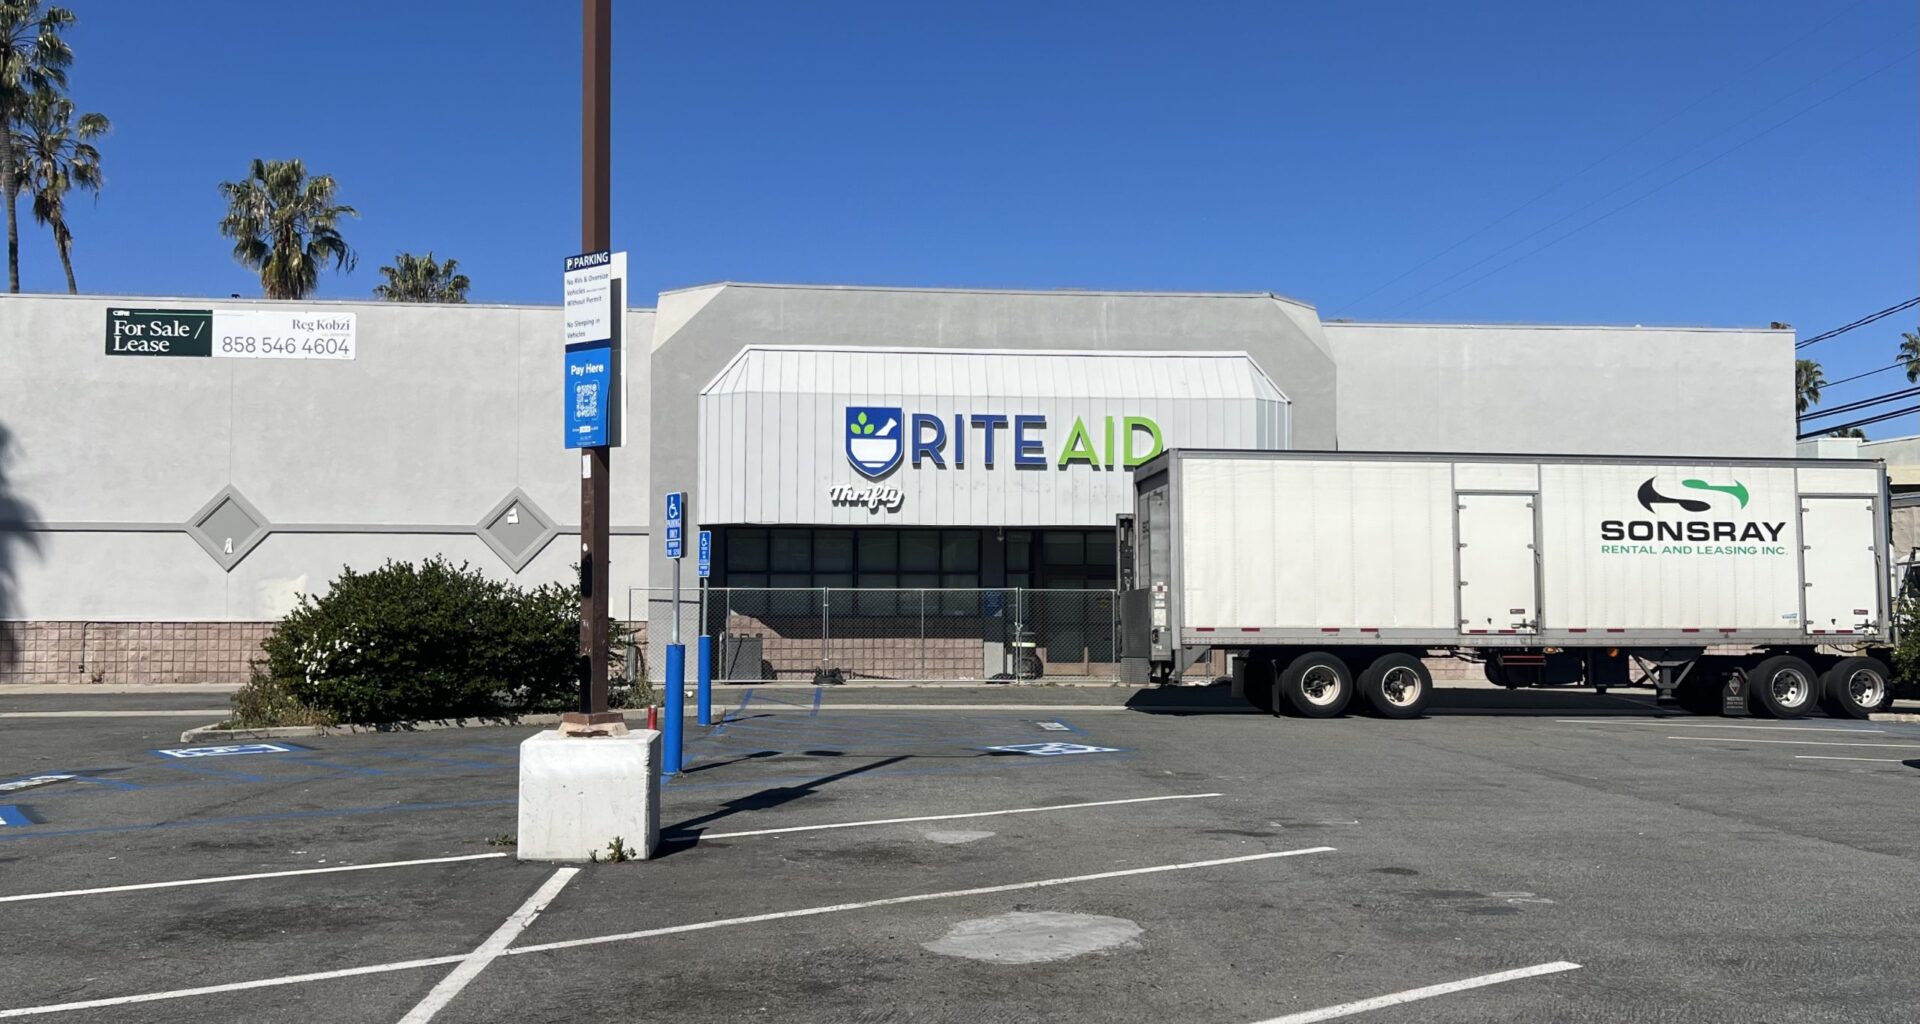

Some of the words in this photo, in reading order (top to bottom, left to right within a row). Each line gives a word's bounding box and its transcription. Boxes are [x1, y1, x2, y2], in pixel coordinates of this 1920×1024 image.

[574, 252, 608, 268] PARKING
[113, 320, 146, 336] For
[150, 320, 190, 337] Sale
[194, 320, 205, 340] /
[292, 320, 314, 332] Reg
[316, 320, 350, 330] Kobzi
[574, 319, 594, 327] Sleeping
[566, 330, 586, 338] Vehicles
[112, 335, 170, 352] Lease
[222, 336, 256, 353] 858
[262, 337, 296, 354] 546
[302, 338, 350, 355] 4604
[570, 364, 584, 376] Pay
[585, 363, 604, 374] Here
[911, 412, 1048, 466] RITE
[1058, 415, 1164, 467] AID
[829, 484, 904, 512] Thrifty
[1601, 520, 1786, 542] SONSRAY
[1601, 545, 1657, 554] RENTAL
[1662, 546, 1692, 555] AND
[1696, 546, 1758, 555] LEASING
[1762, 546, 1788, 556] INC.
